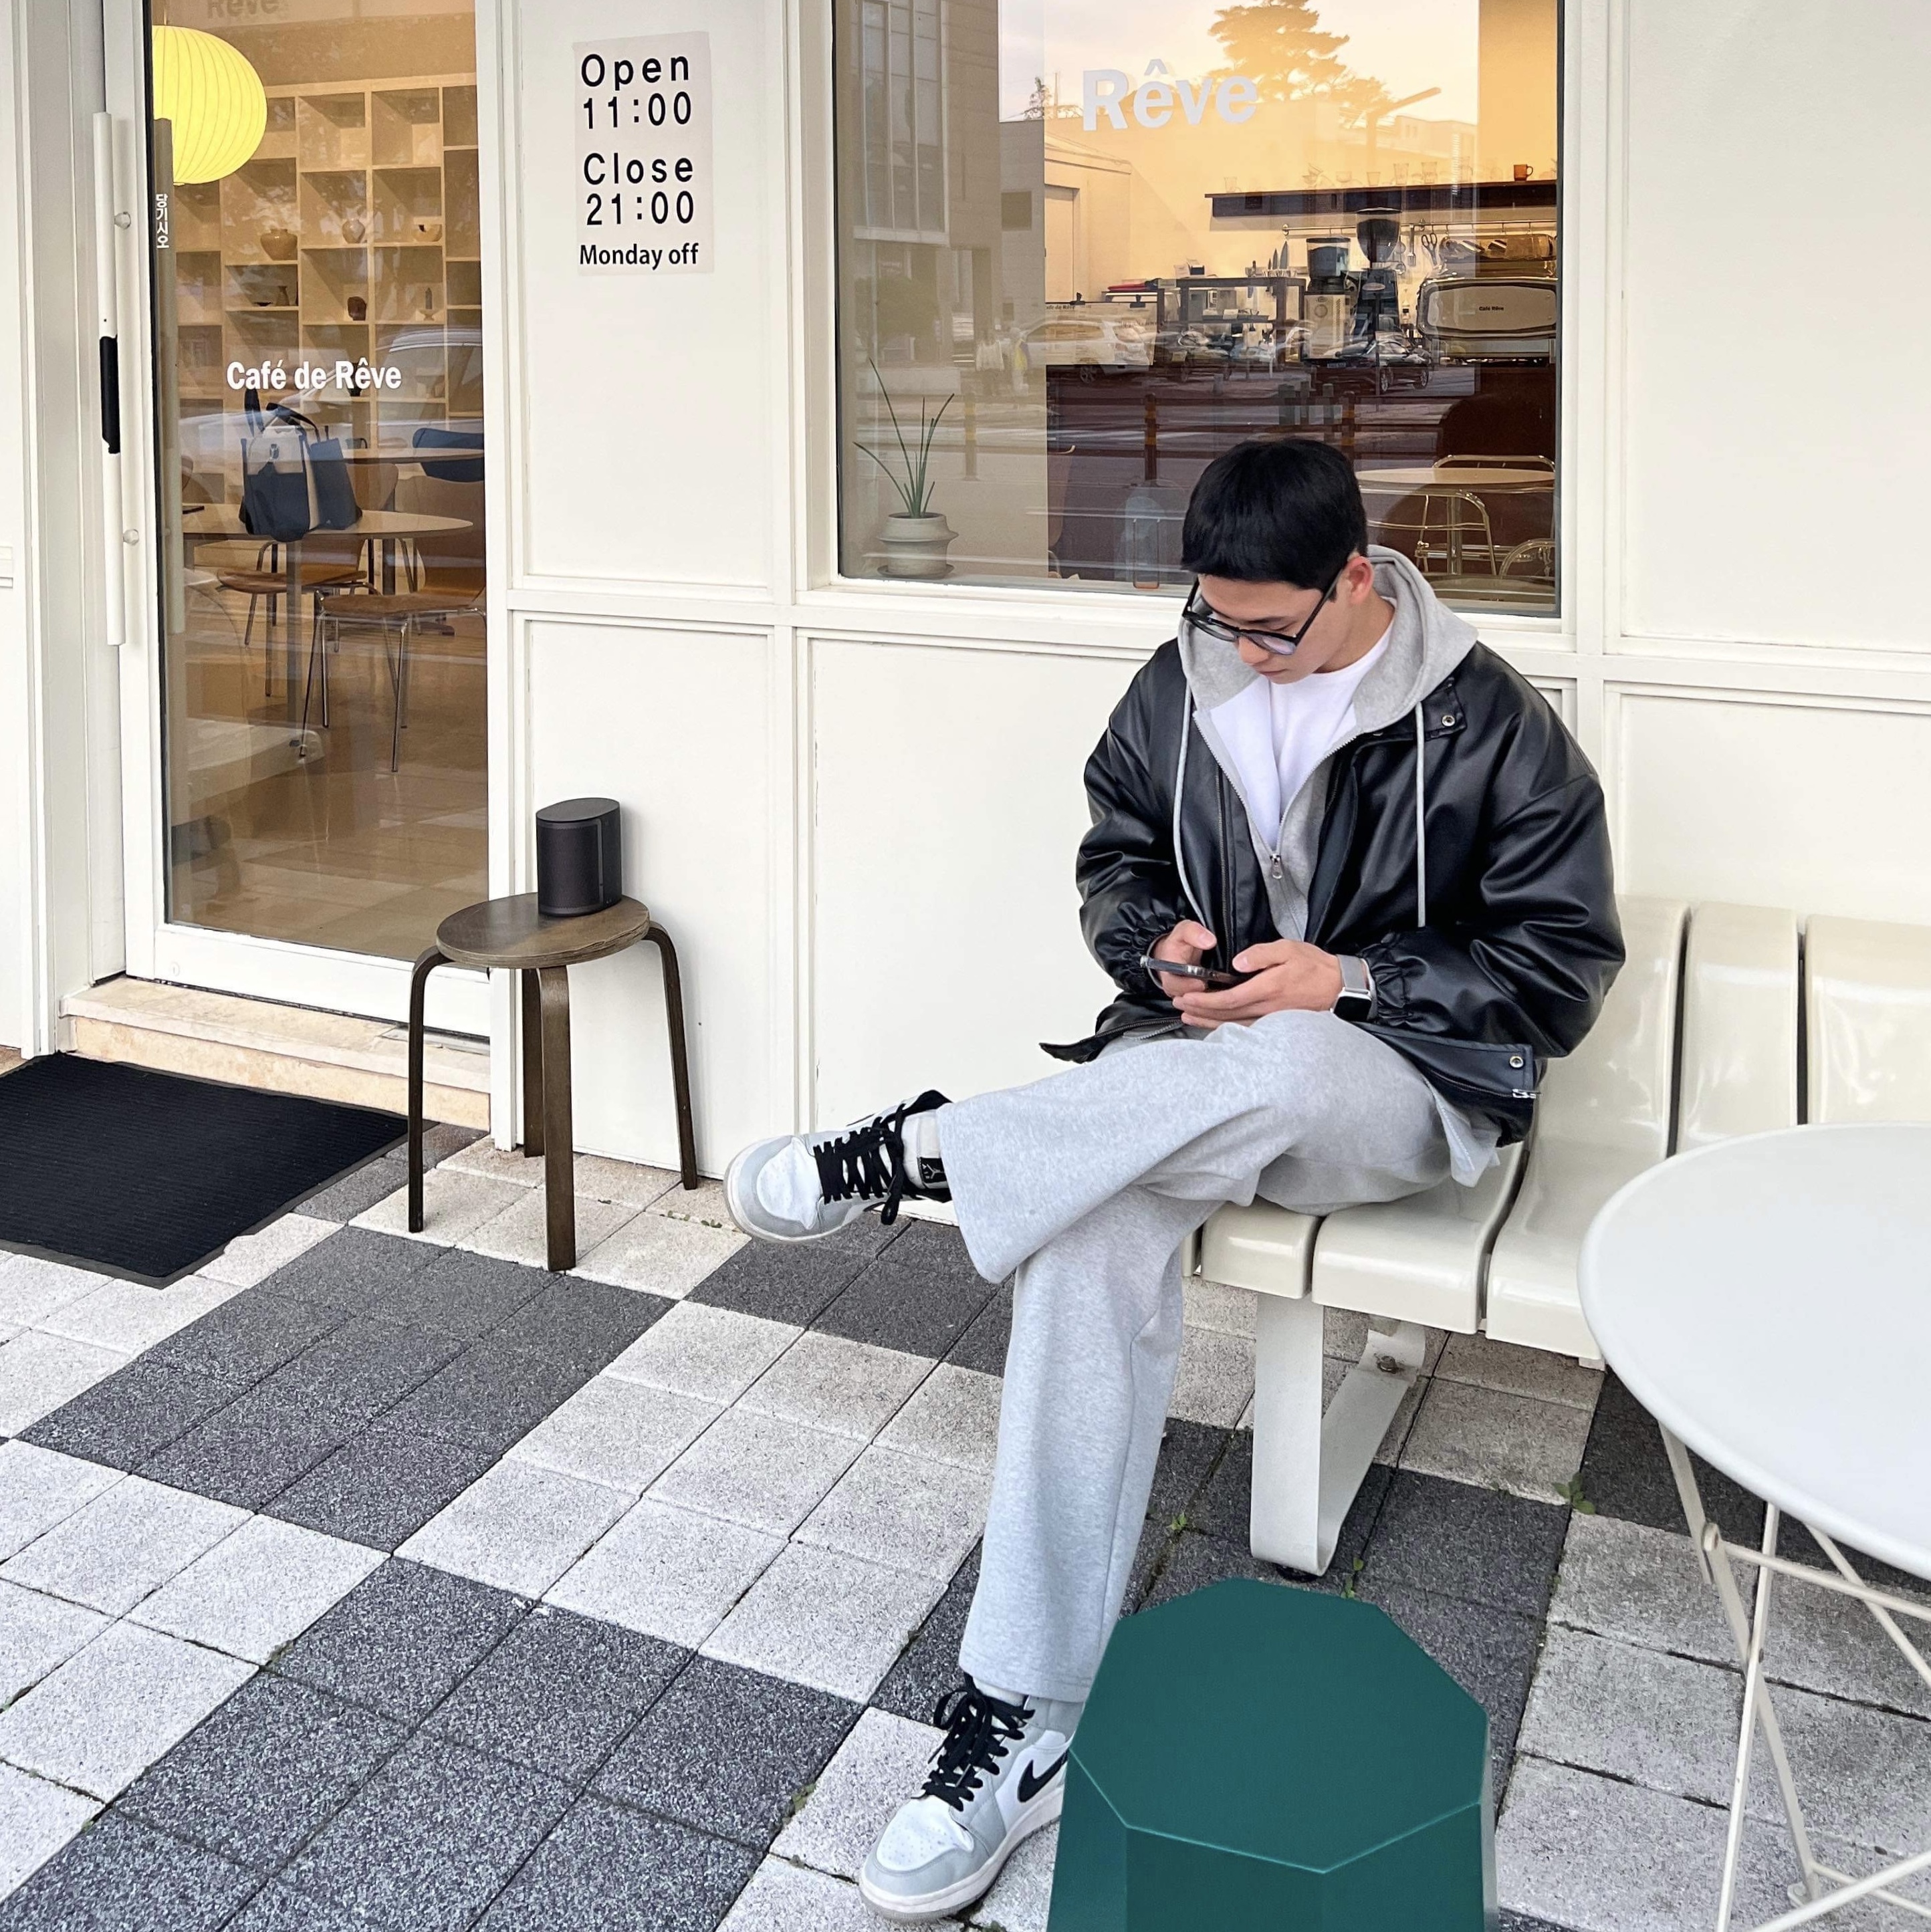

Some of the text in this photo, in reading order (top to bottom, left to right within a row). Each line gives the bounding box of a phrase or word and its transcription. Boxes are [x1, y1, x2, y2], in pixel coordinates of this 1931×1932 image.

[581, 53, 689, 91] Open
[583, 91, 692, 129] 11:00
[1083, 58, 1258, 131] Rêve
[584, 152, 693, 185] Close
[156, 193, 170, 249] 당기시오
[586, 191, 694, 225] 21:00
[580, 242, 699, 271] Monday off
[227, 357, 401, 390] Café de Rêve
